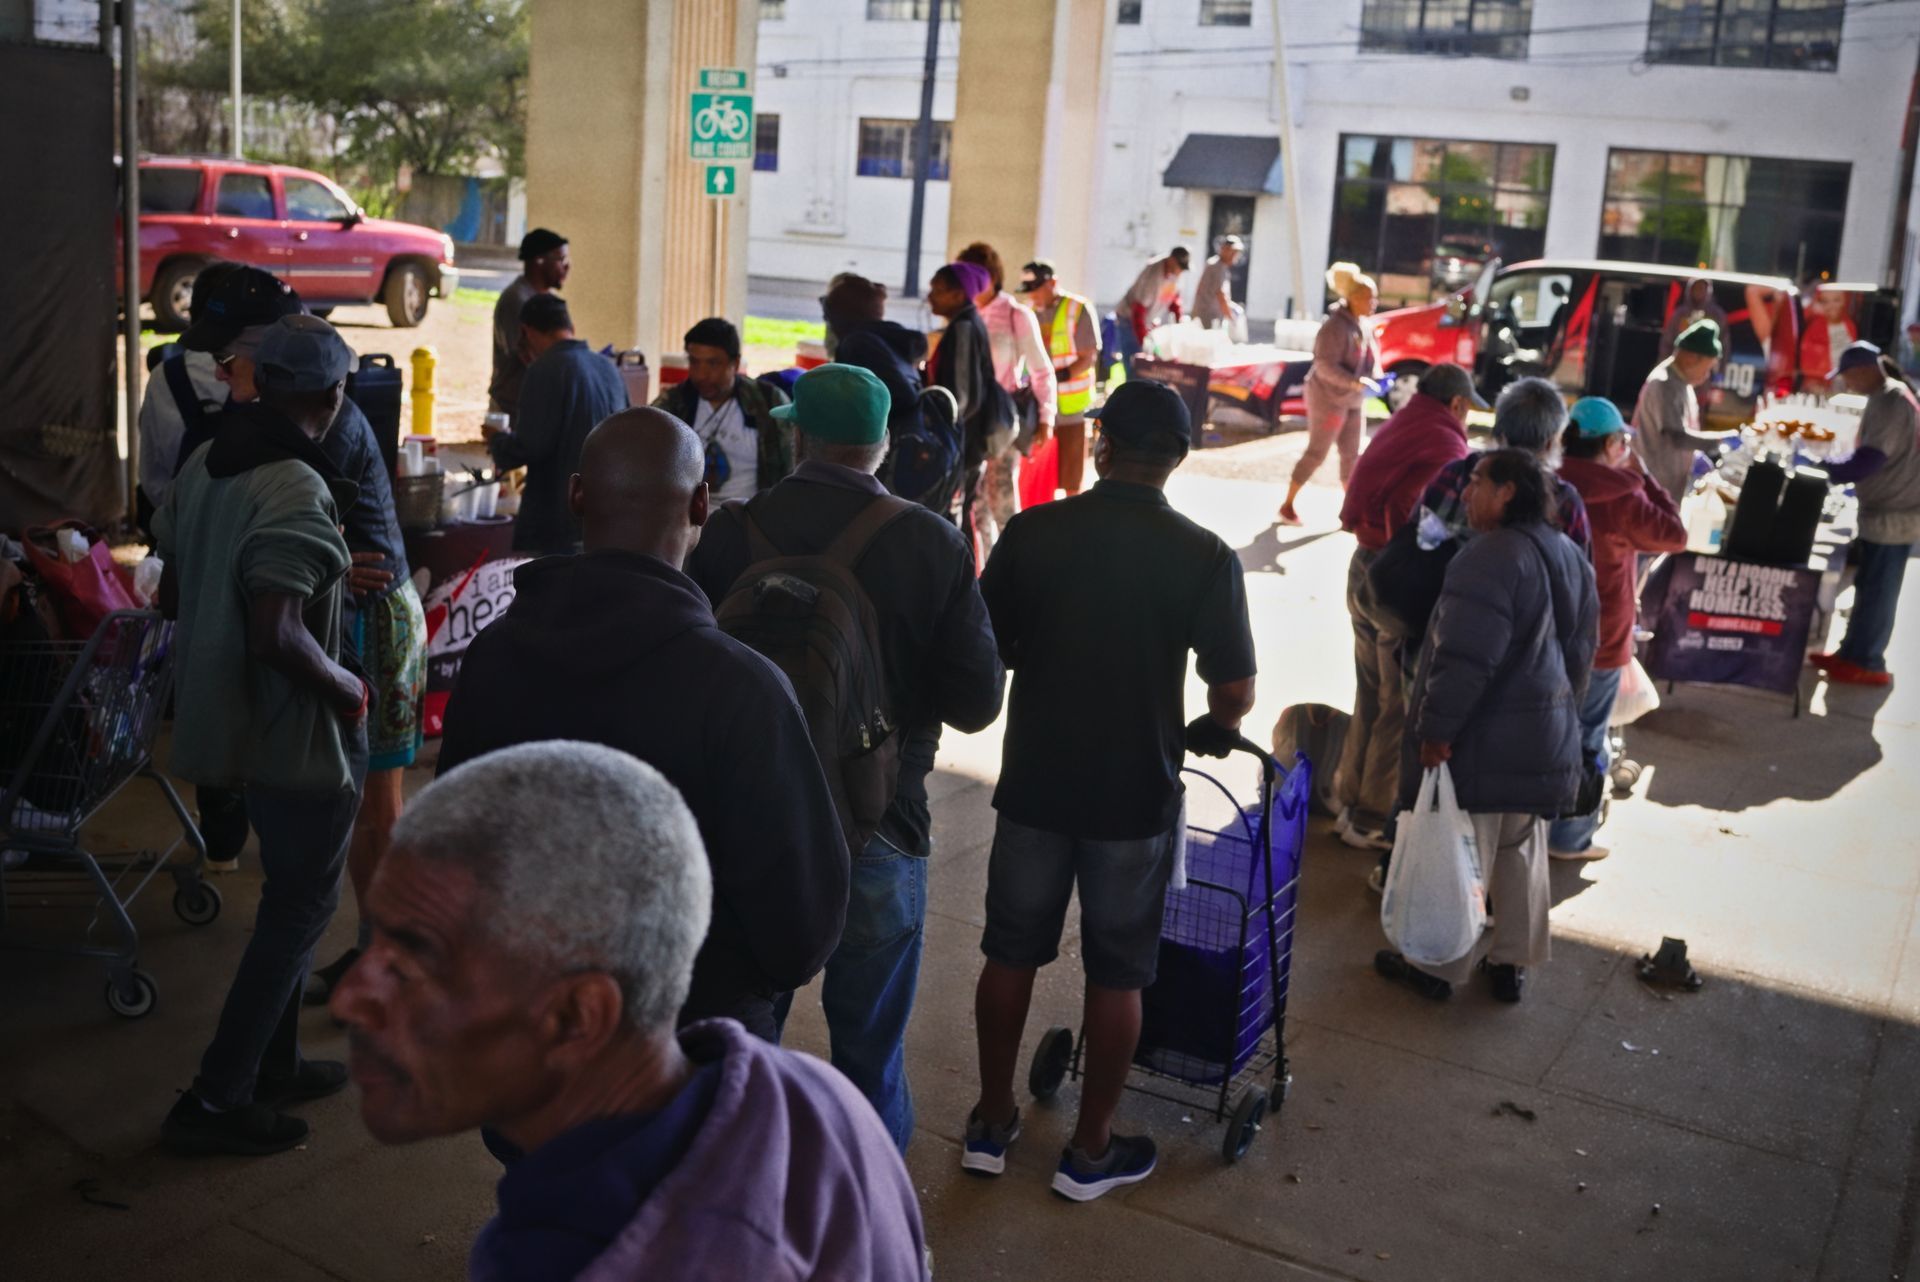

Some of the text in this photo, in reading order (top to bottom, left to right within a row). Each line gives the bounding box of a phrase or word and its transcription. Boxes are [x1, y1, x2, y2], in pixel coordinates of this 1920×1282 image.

[1694, 556, 1728, 576] BUY
[1726, 561, 1739, 579] A
[1703, 571, 1786, 602] HELP THE
